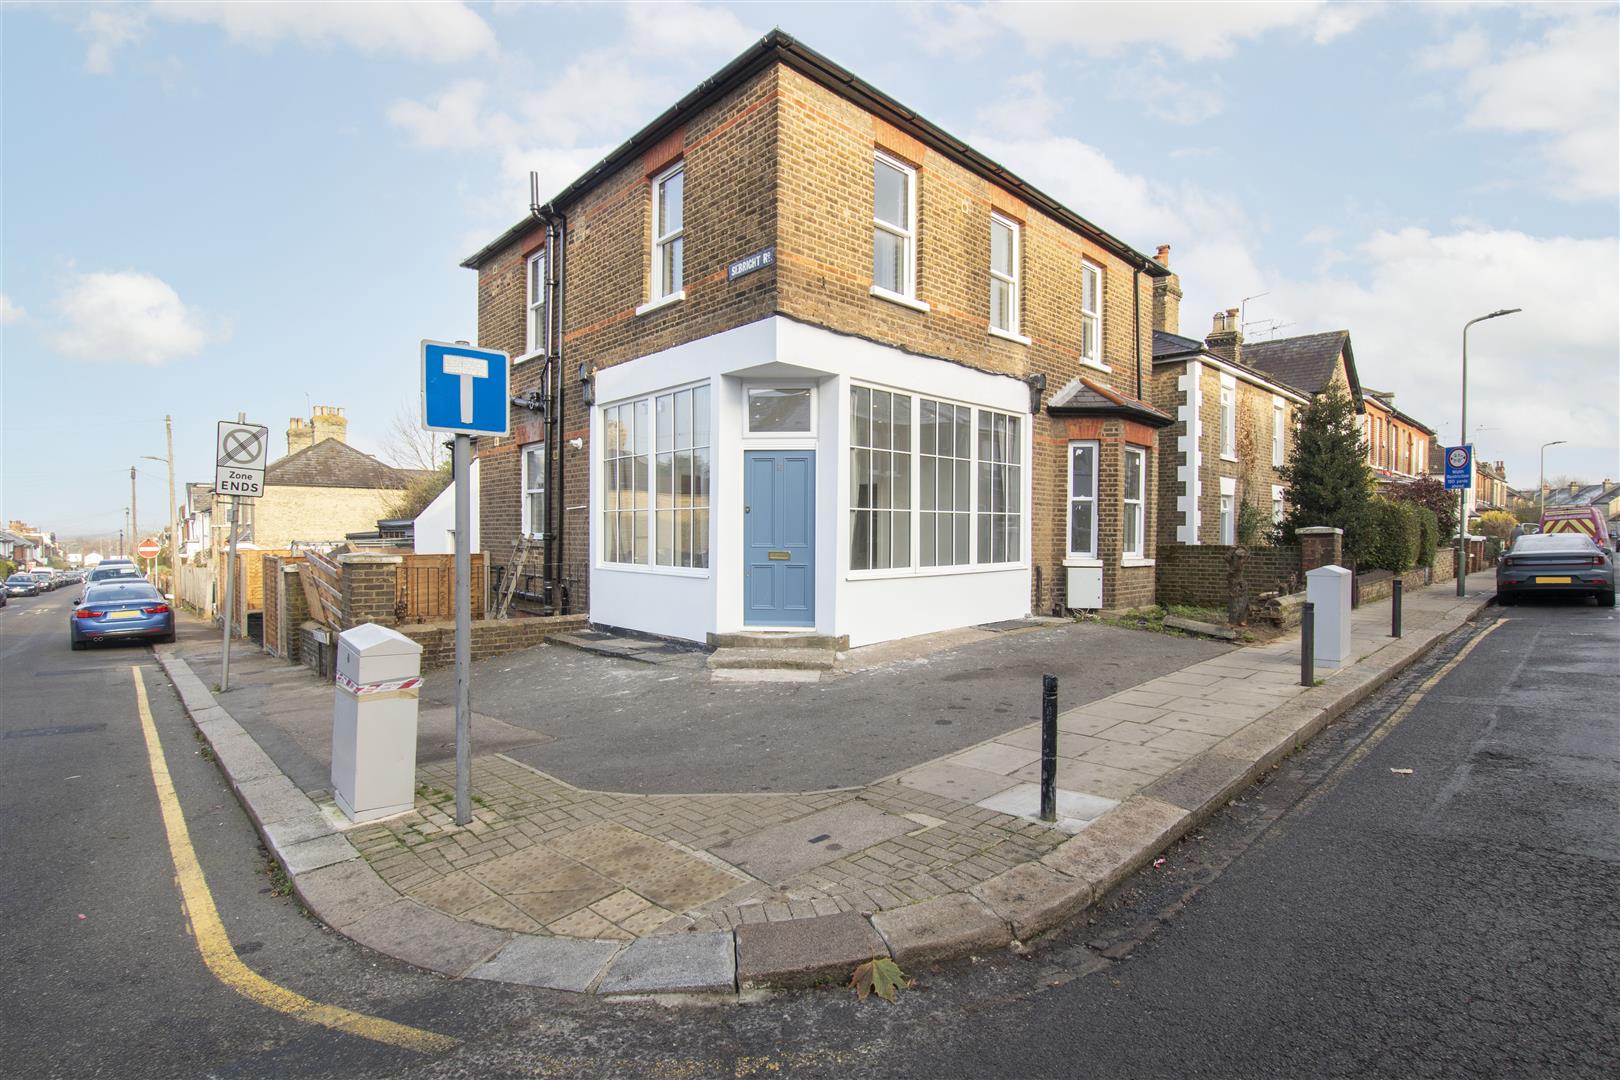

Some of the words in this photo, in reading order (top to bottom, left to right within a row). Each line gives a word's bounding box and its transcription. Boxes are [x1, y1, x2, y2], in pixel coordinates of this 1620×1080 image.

[731, 255, 761, 276] SEBRIGHT
[229, 470, 253, 481] Zone
[221, 480, 259, 493] ENDS
